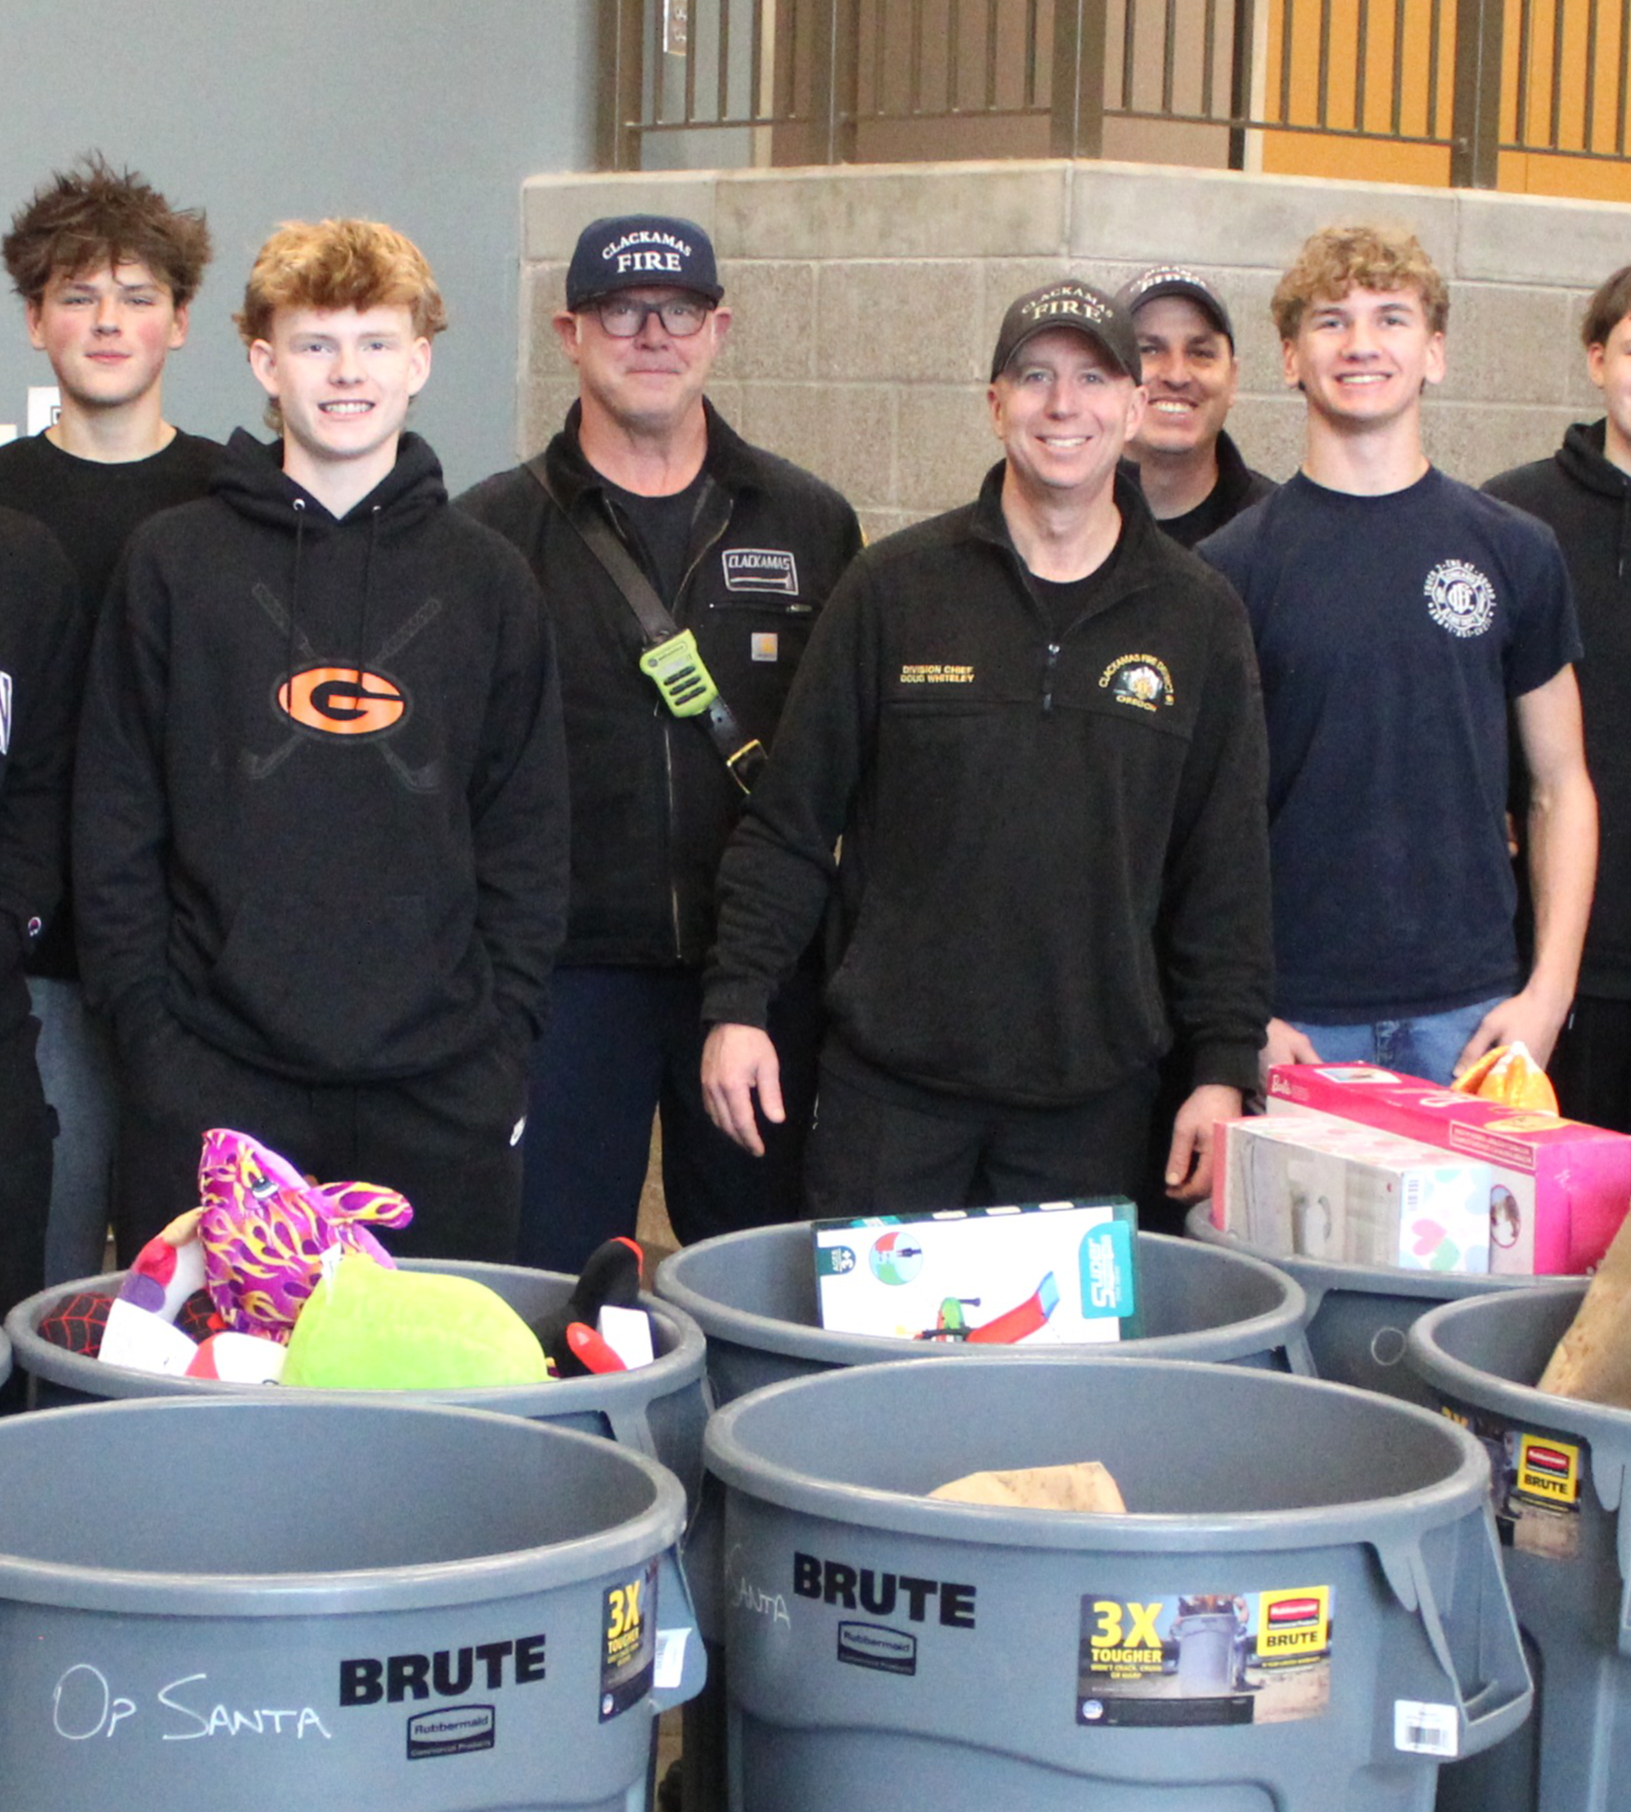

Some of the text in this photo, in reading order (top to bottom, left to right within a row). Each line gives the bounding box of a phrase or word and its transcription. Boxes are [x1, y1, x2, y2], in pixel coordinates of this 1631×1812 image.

[601, 230, 692, 260] CLACKAMAS
[617, 251, 682, 274] FIRE
[1021, 286, 1114, 319] CLACKAMAS
[1032, 300, 1102, 324] FIRE
[728, 554, 791, 570] CLACKAMAS
[278, 667, 405, 735] G
[840, 1250, 853, 1270] 3+
[1524, 1474, 1568, 1494] BRUTE
[793, 1551, 977, 1629] BRUTE
[608, 1579, 641, 1640] 3X
[1091, 1601, 1163, 1648] 3X
[1266, 1631, 1319, 1648] BRUTE
[1091, 1648, 1163, 1663] TOUGHER
[339, 1634, 546, 1707] BRUTE
[414, 1715, 489, 1735] Rubbermaid
